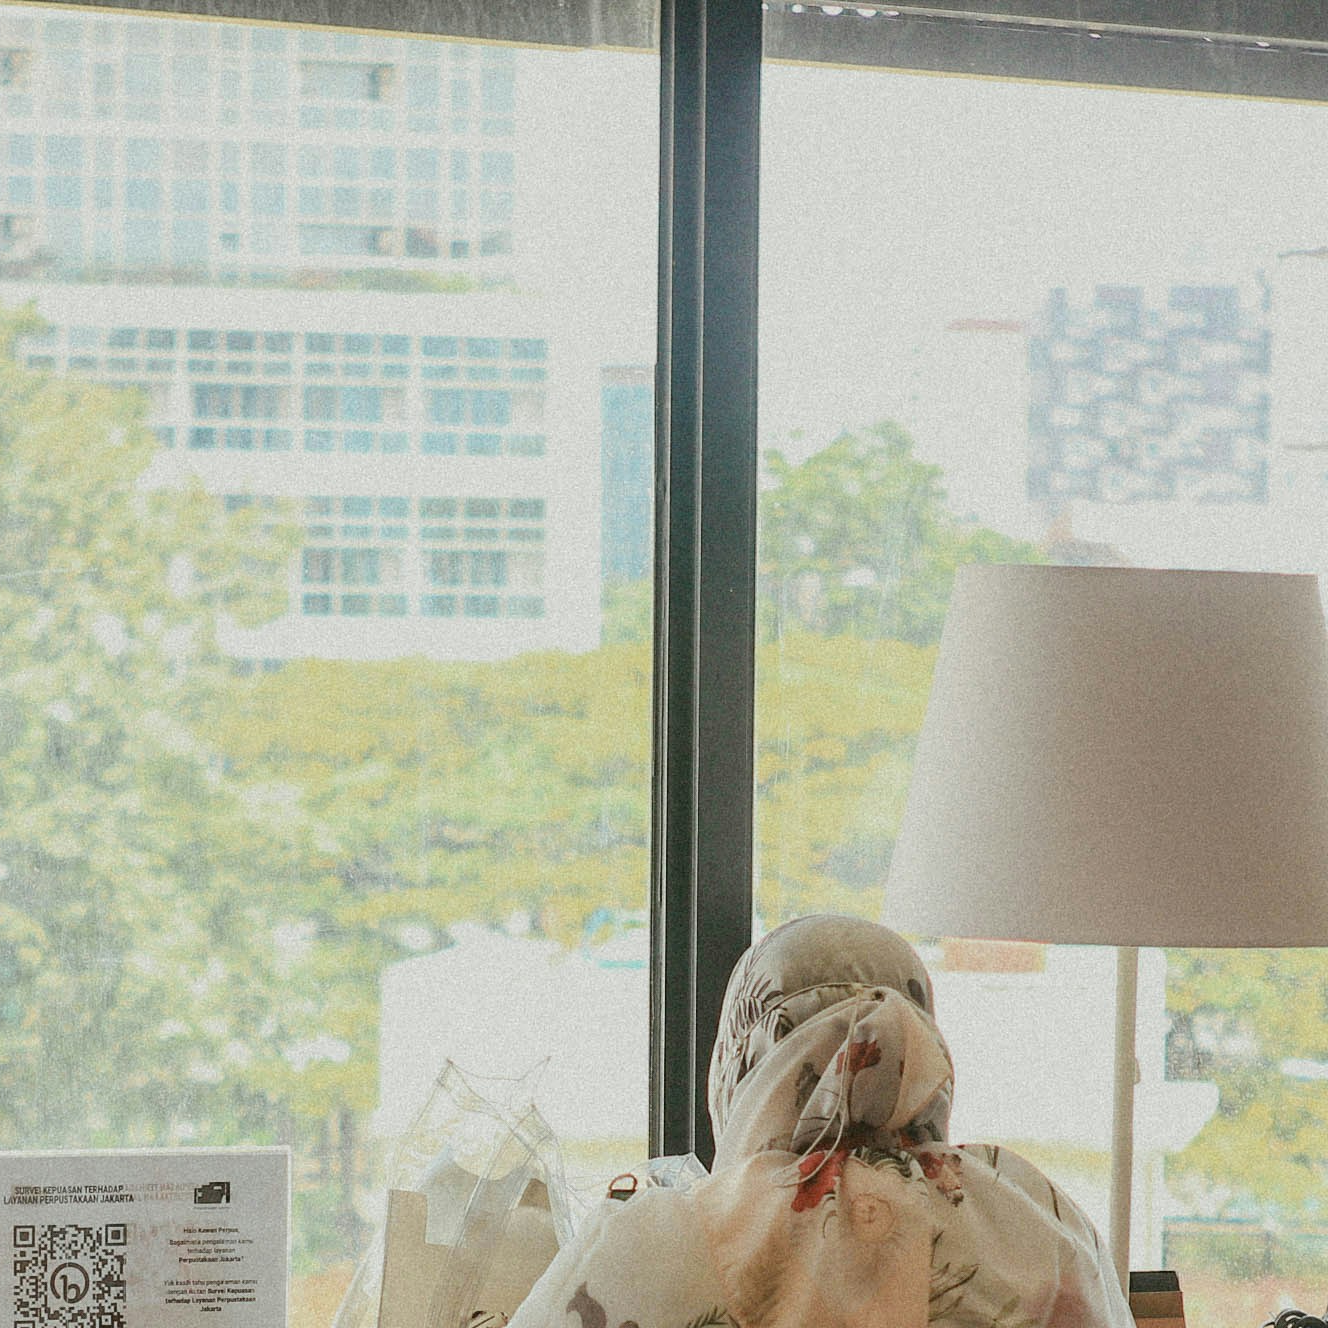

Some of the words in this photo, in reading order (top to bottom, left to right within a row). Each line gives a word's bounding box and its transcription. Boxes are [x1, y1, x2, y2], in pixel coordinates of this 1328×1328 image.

[14, 1186, 42, 1195] SURVEI
[43, 1186, 83, 1194] KEPUASAN
[84, 1185, 124, 1193] TERHADAP
[3, 1196, 38, 1205] LAYANAN
[39, 1195, 99, 1204] PERPUSTAKAAN
[100, 1194, 134, 1203] JAKARTA
